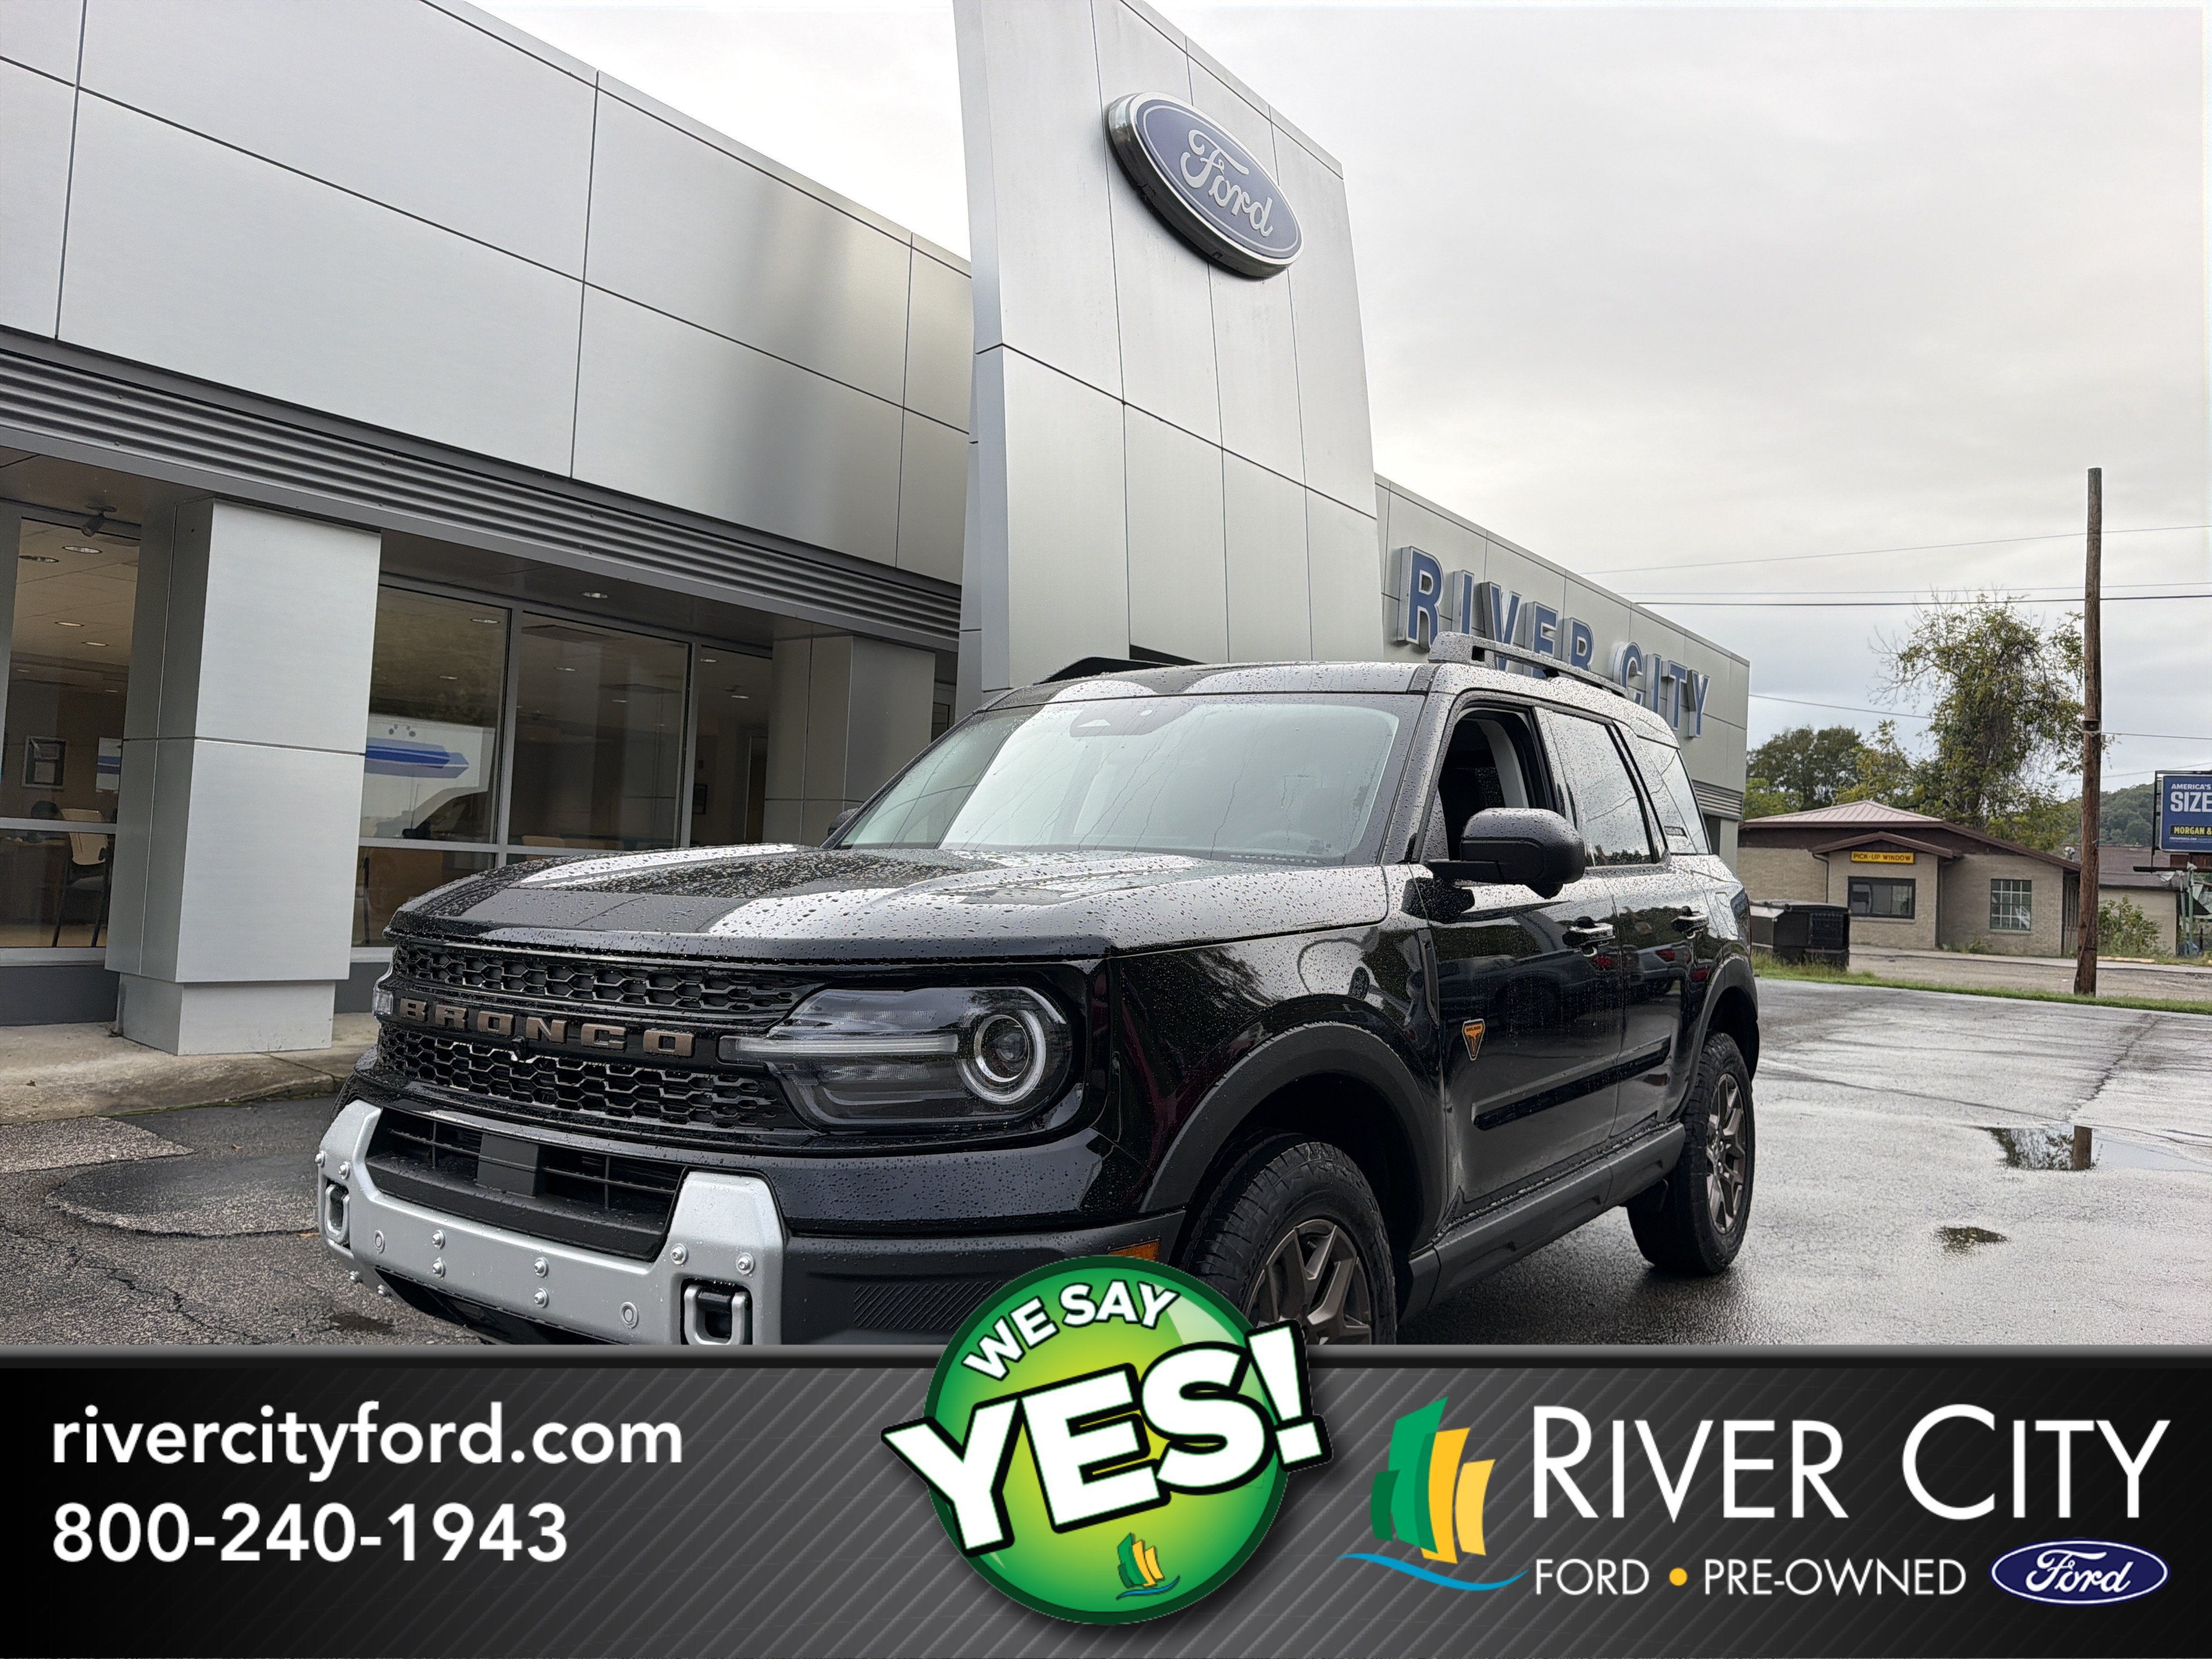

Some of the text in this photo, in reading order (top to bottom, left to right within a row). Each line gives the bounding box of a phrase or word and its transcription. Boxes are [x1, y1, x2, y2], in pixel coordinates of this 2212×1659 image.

[1180, 129, 1273, 237] Ford
[1399, 546, 1710, 738] RIVER CITY
[2170, 791, 2212, 812] SIZE
[2174, 826, 2205, 834] MORGAN
[399, 997, 695, 1057] BRONCO
